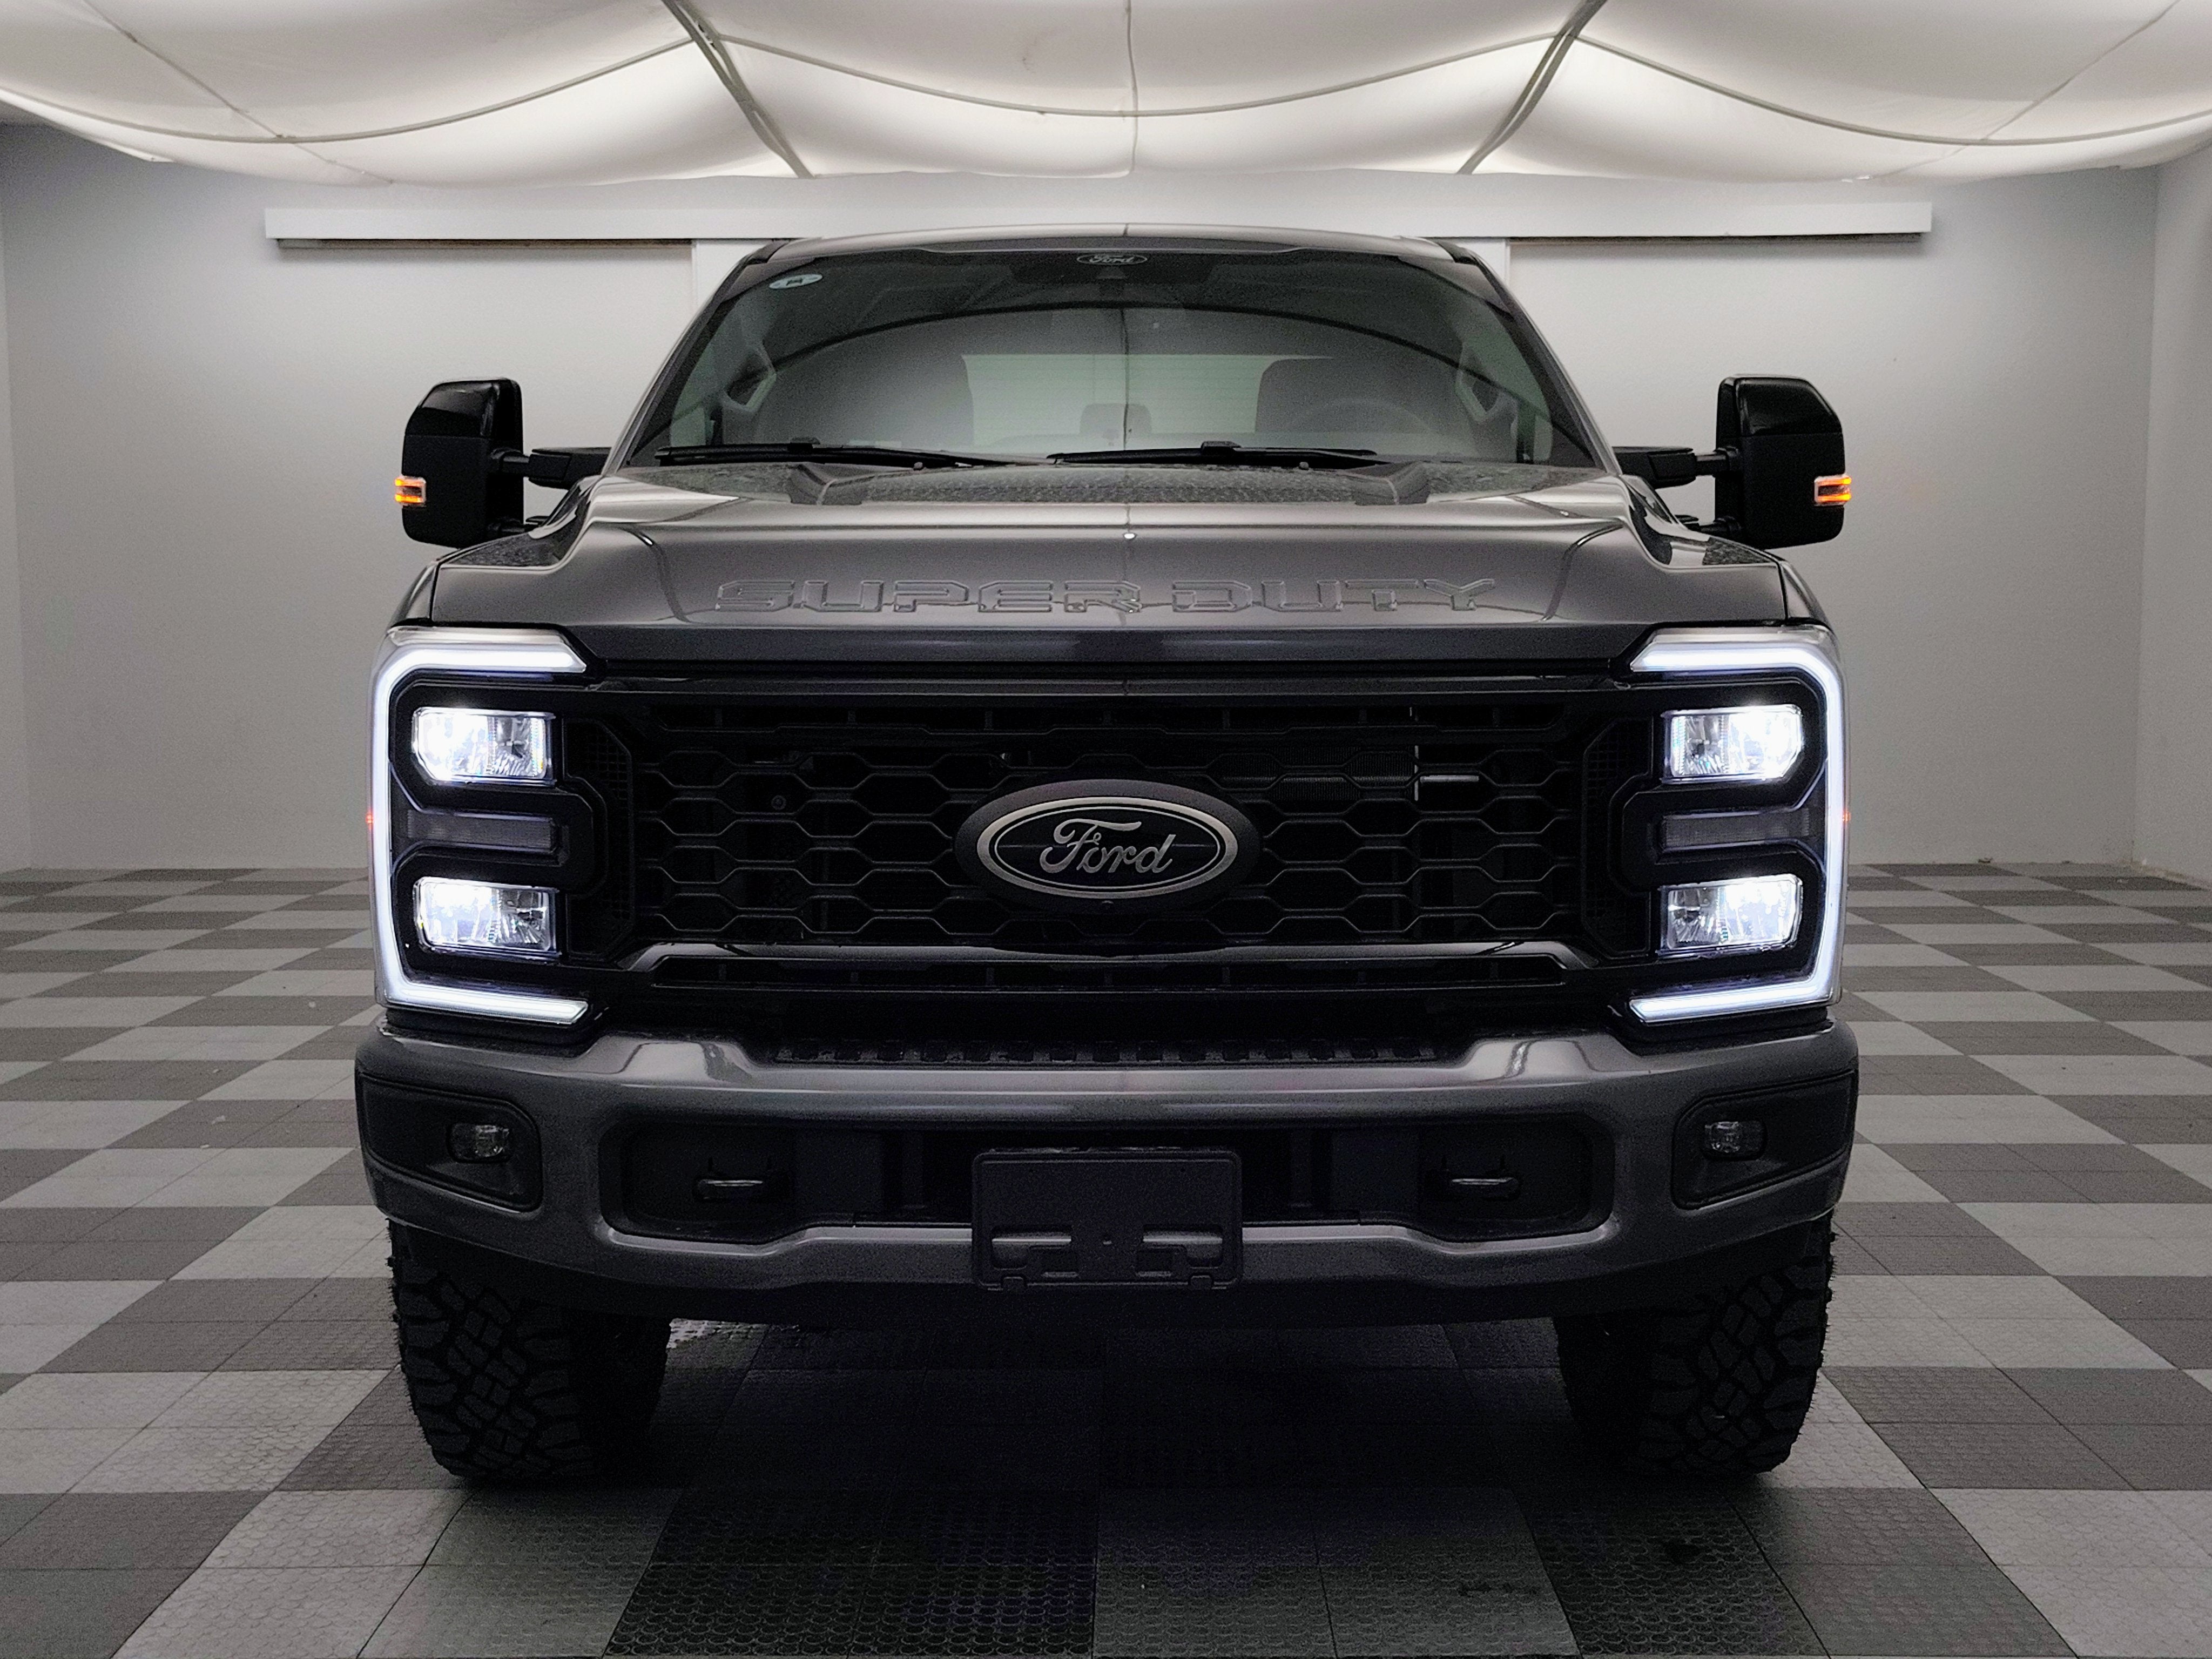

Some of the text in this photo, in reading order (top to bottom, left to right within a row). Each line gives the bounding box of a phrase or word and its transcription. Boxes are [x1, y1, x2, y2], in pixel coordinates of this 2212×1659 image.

[716, 579, 1495, 612] SUPER DUTY
[1039, 818, 1177, 874] Ford
